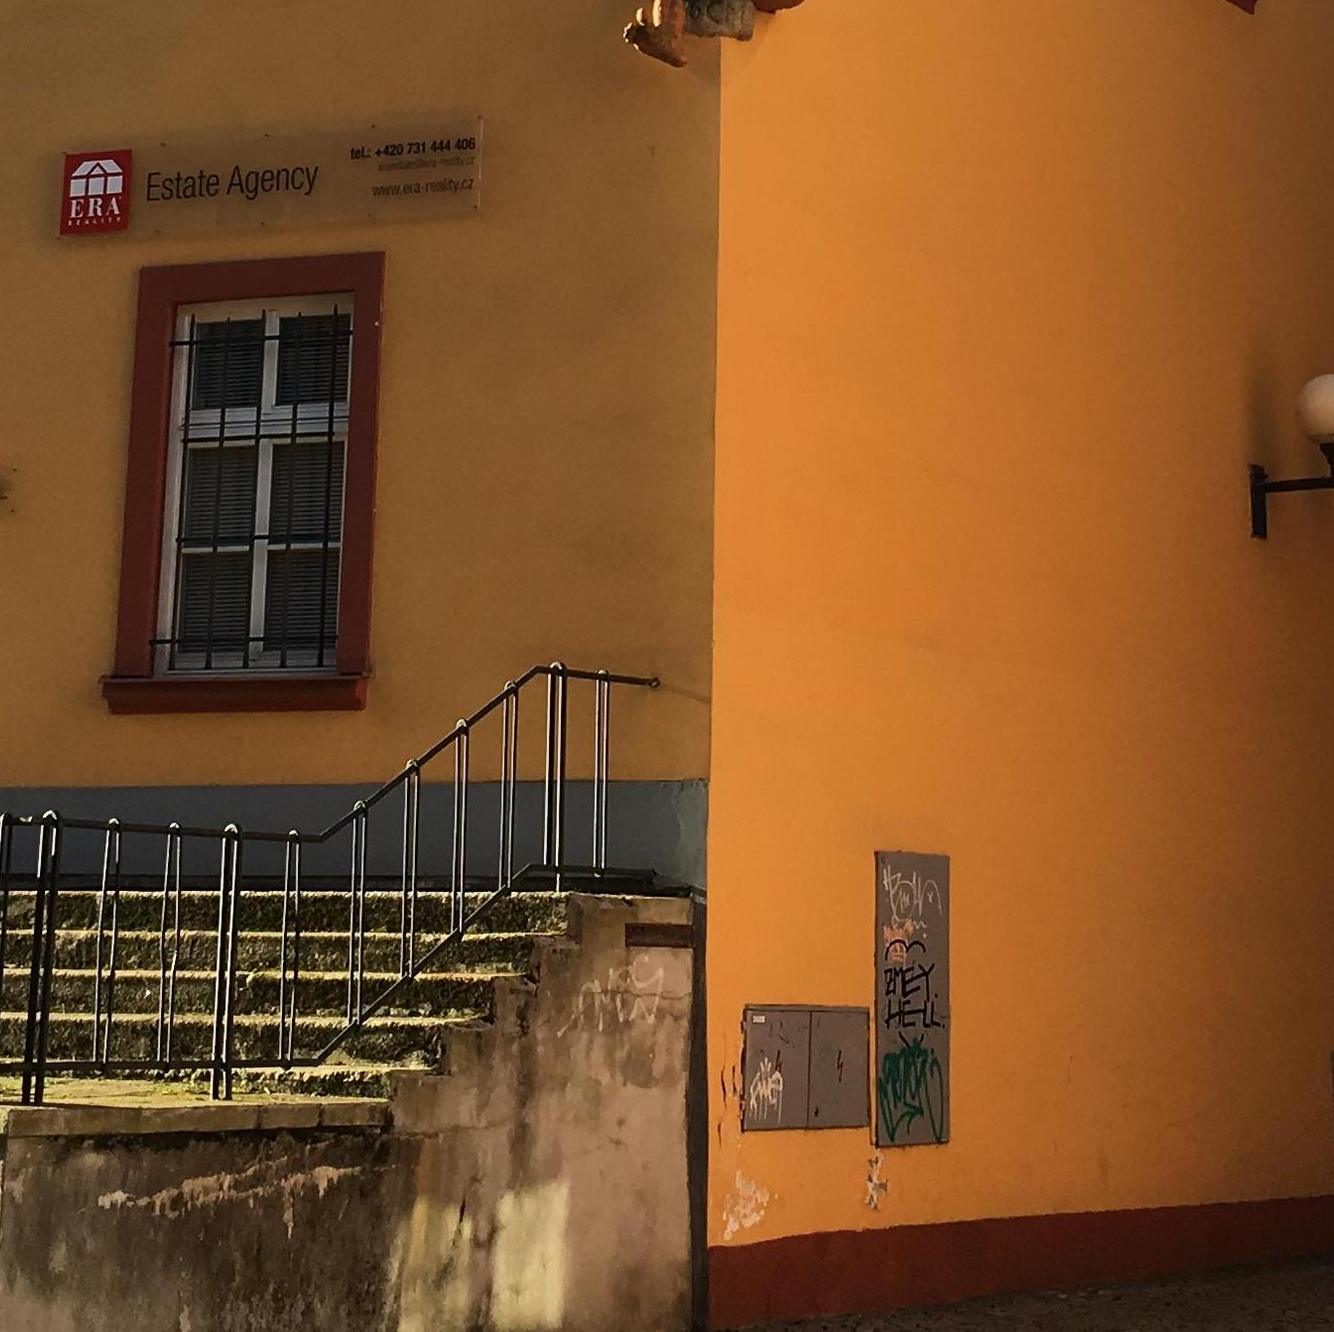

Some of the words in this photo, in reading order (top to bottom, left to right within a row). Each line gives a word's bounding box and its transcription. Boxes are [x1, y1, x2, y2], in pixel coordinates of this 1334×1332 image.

[374, 143, 404, 157] +420
[407, 141, 426, 155] 731
[430, 139, 451, 152] 444
[146, 171, 220, 202] Estate
[226, 164, 319, 198] Agency
[68, 197, 121, 219] ERA
